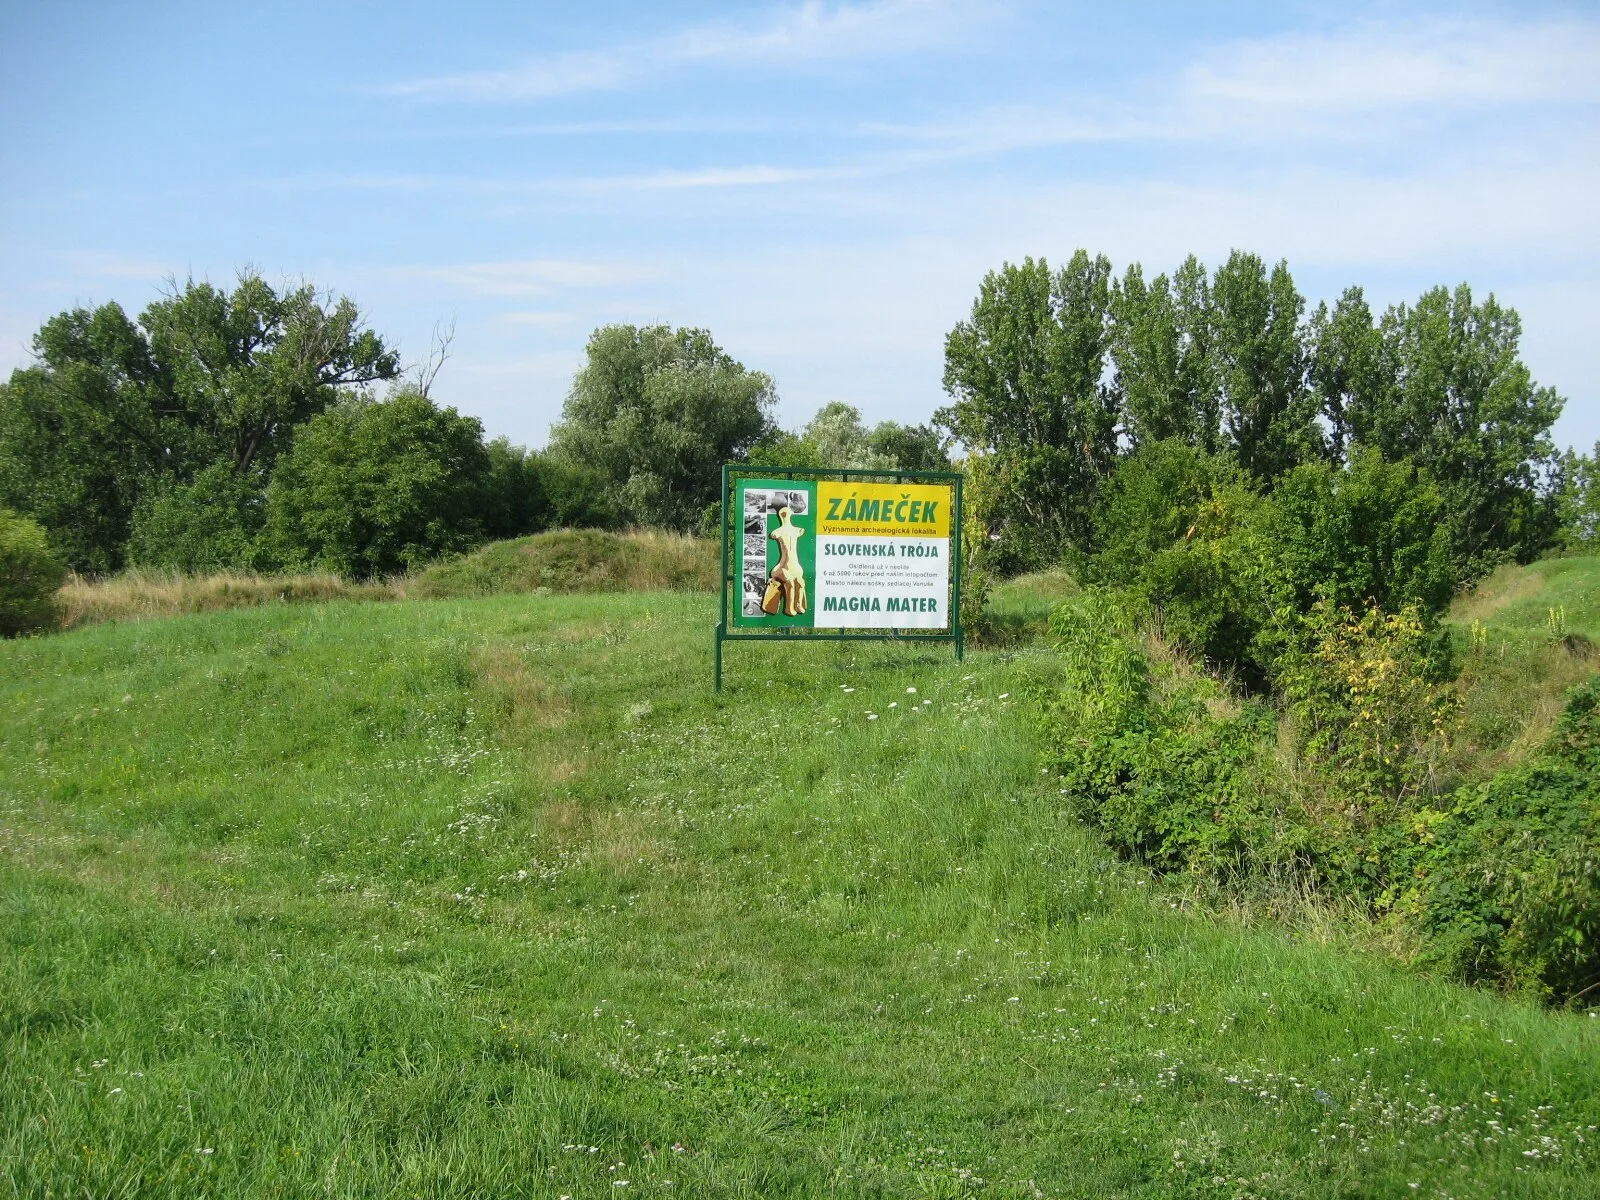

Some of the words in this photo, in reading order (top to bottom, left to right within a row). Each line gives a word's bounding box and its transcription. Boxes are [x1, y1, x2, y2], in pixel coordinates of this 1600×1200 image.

[825, 491, 938, 523] ZÁMEČEK
[823, 525, 859, 534] Významná
[861, 526, 910, 536] archeologická
[911, 527, 937, 535] lokalita
[824, 541, 896, 557] SLOVENSKÁ
[900, 542, 939, 558] TRÓJA
[823, 596, 881, 612] MAGNA
[886, 597, 938, 613] MATER
